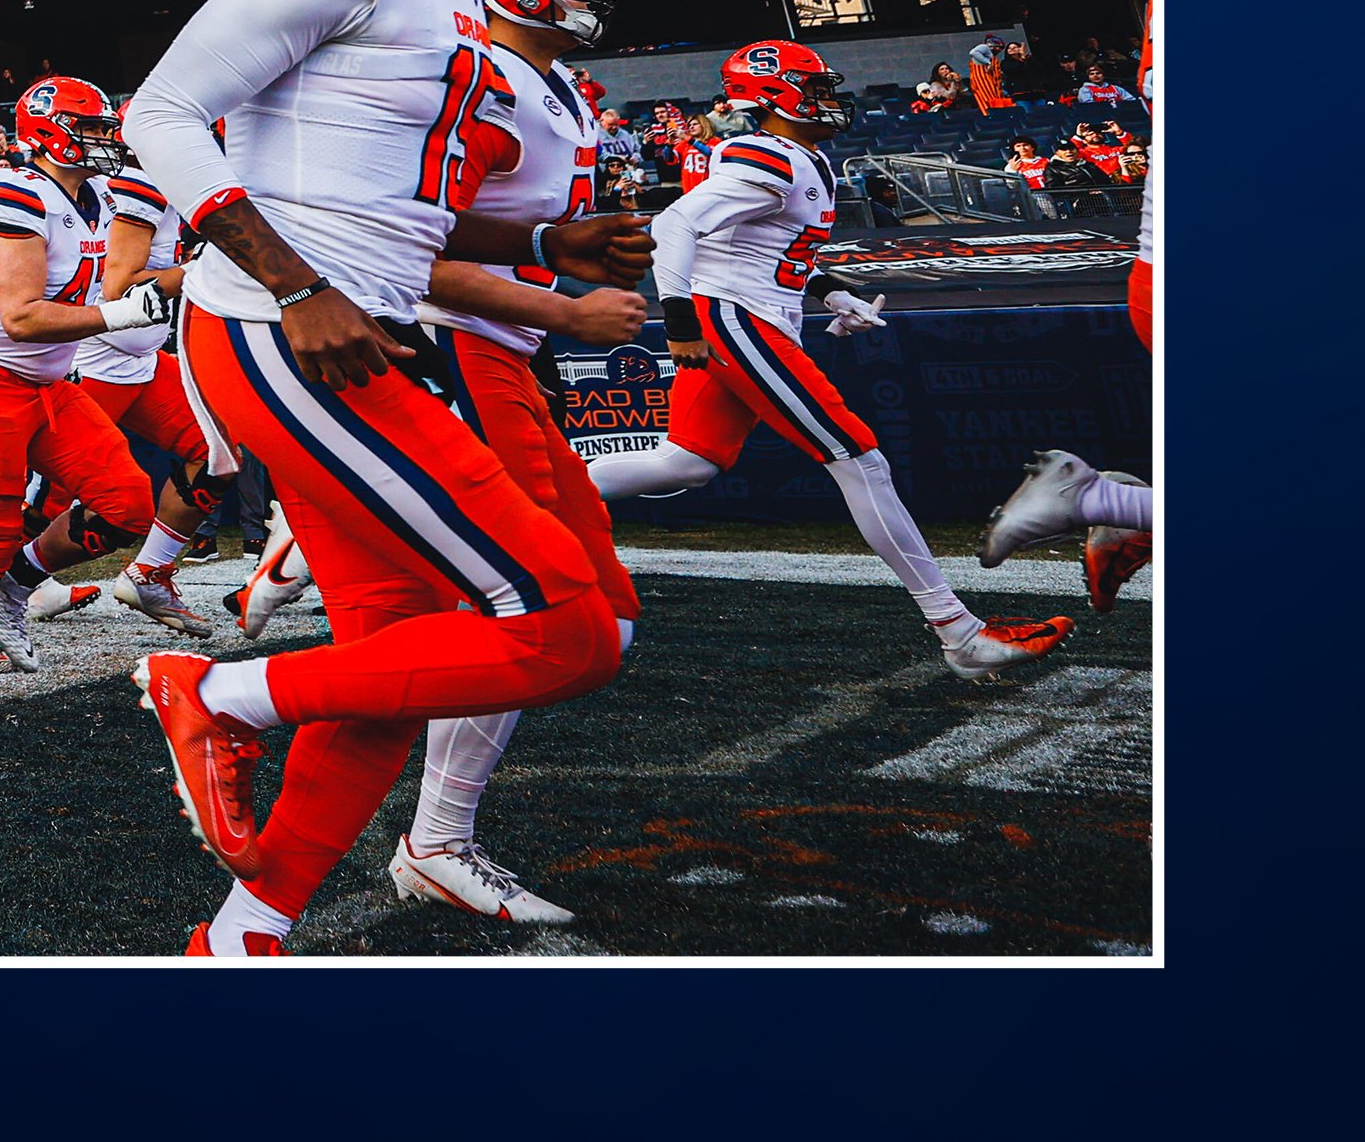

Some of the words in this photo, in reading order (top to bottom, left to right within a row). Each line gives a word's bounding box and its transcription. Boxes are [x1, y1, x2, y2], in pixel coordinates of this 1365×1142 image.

[747, 46, 780, 77] S
[28, 85, 57, 116] S
[685, 153, 707, 173] 48
[80, 240, 106, 254] ORANGE
[564, 409, 670, 428] MOWE
